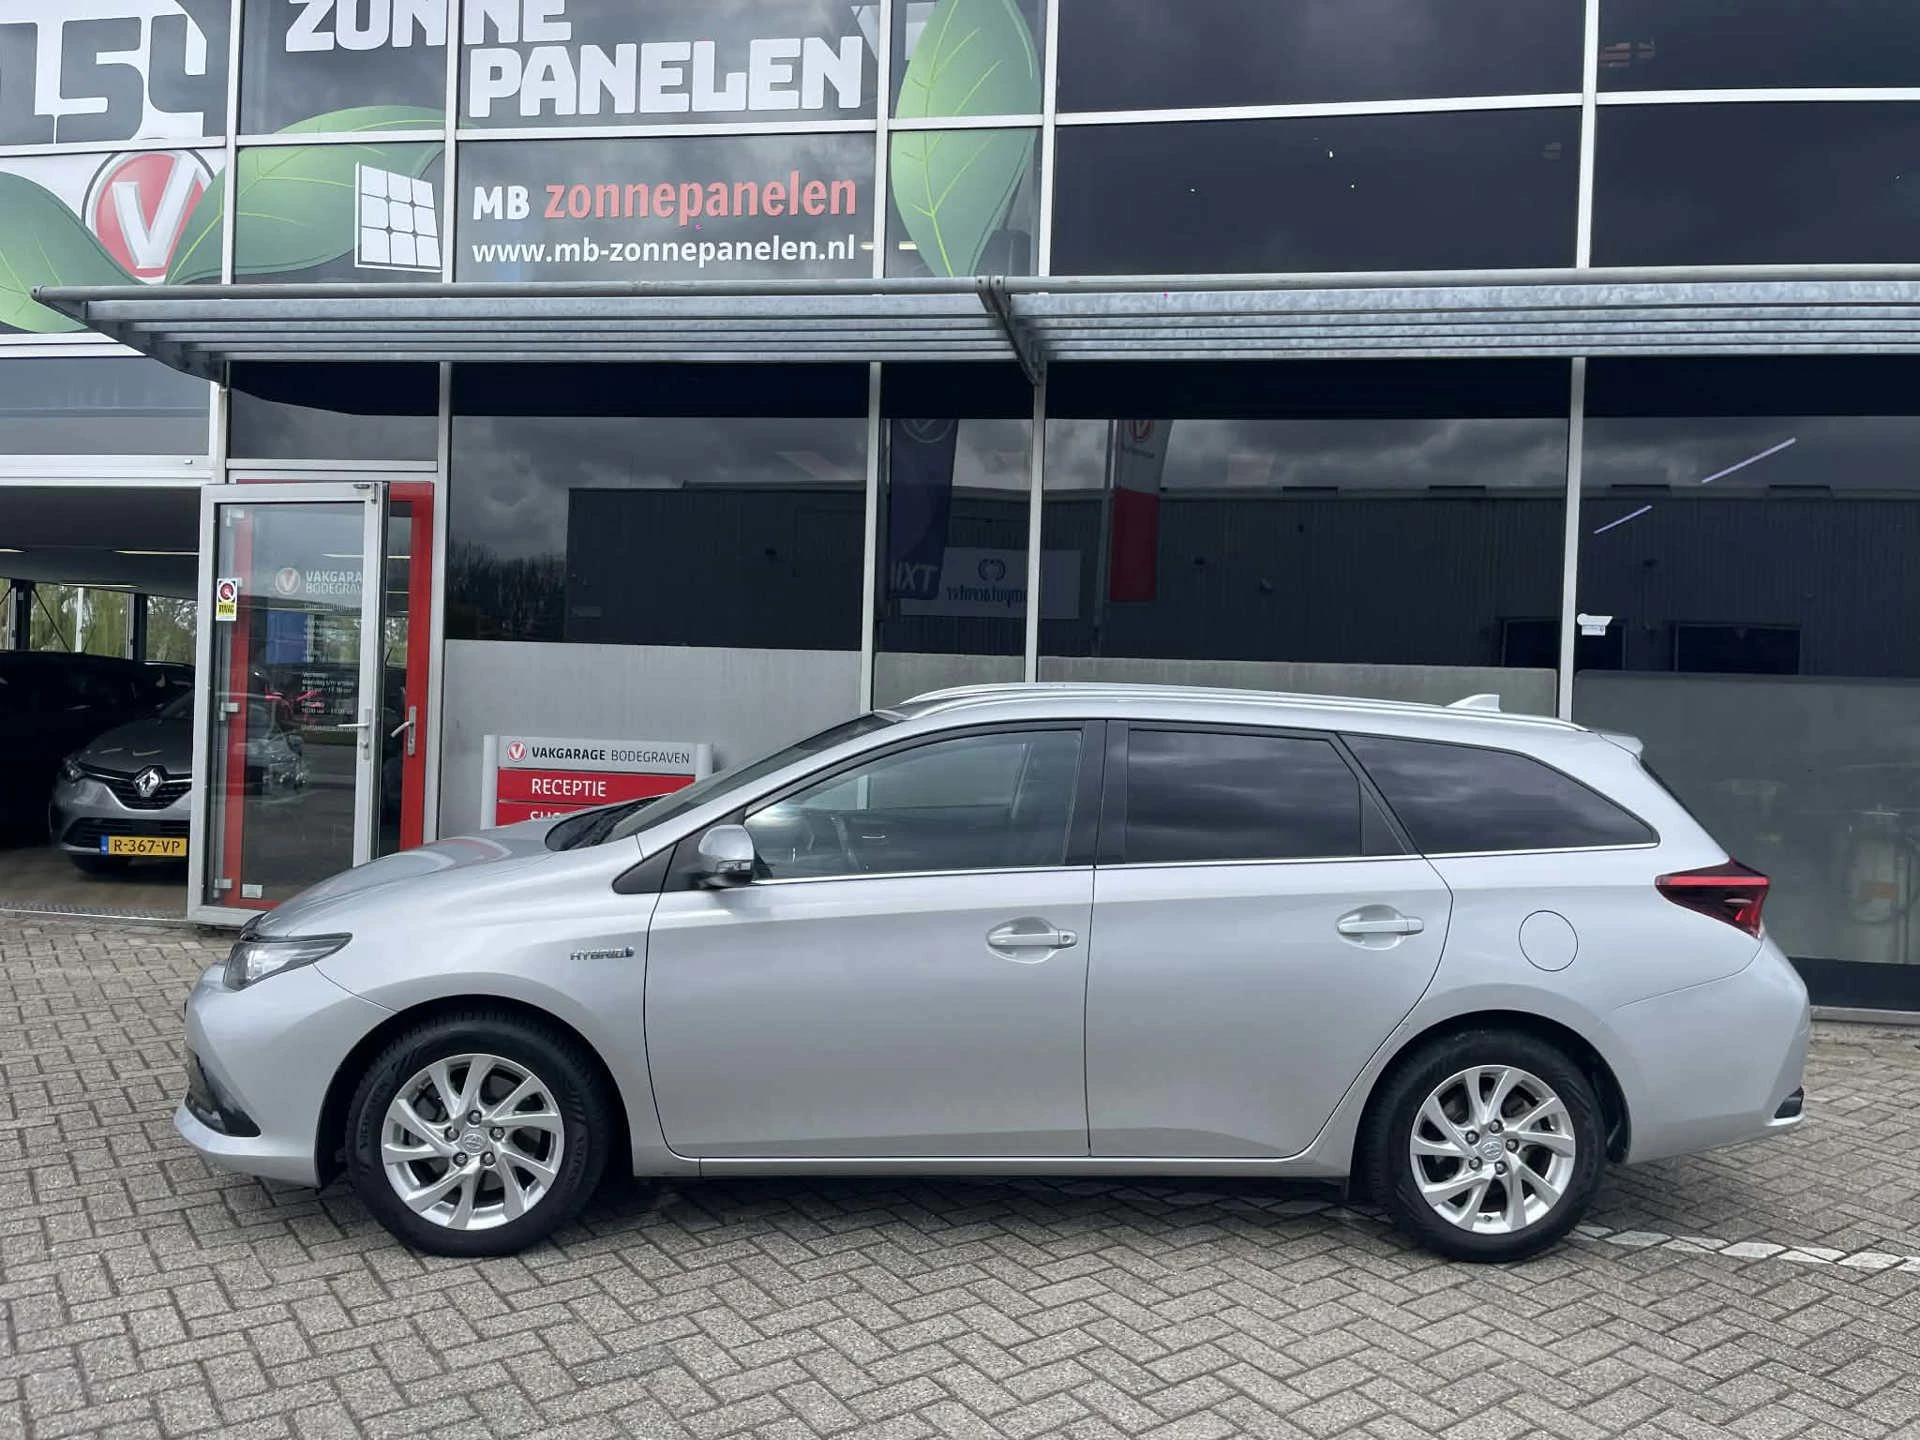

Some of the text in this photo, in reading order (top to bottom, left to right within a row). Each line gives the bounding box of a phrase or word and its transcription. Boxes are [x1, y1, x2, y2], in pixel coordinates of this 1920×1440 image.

[469, 36, 863, 118] PANELEN
[472, 169, 857, 226] MB zonnepanelen
[472, 234, 856, 268] www.mb-zonnepanelen.nl
[531, 746, 606, 761] VAKGARAGE
[611, 749, 690, 765] BODEGRAVEN
[531, 778, 607, 797] RECEPTIE
[113, 839, 180, 853] R-367-VP
